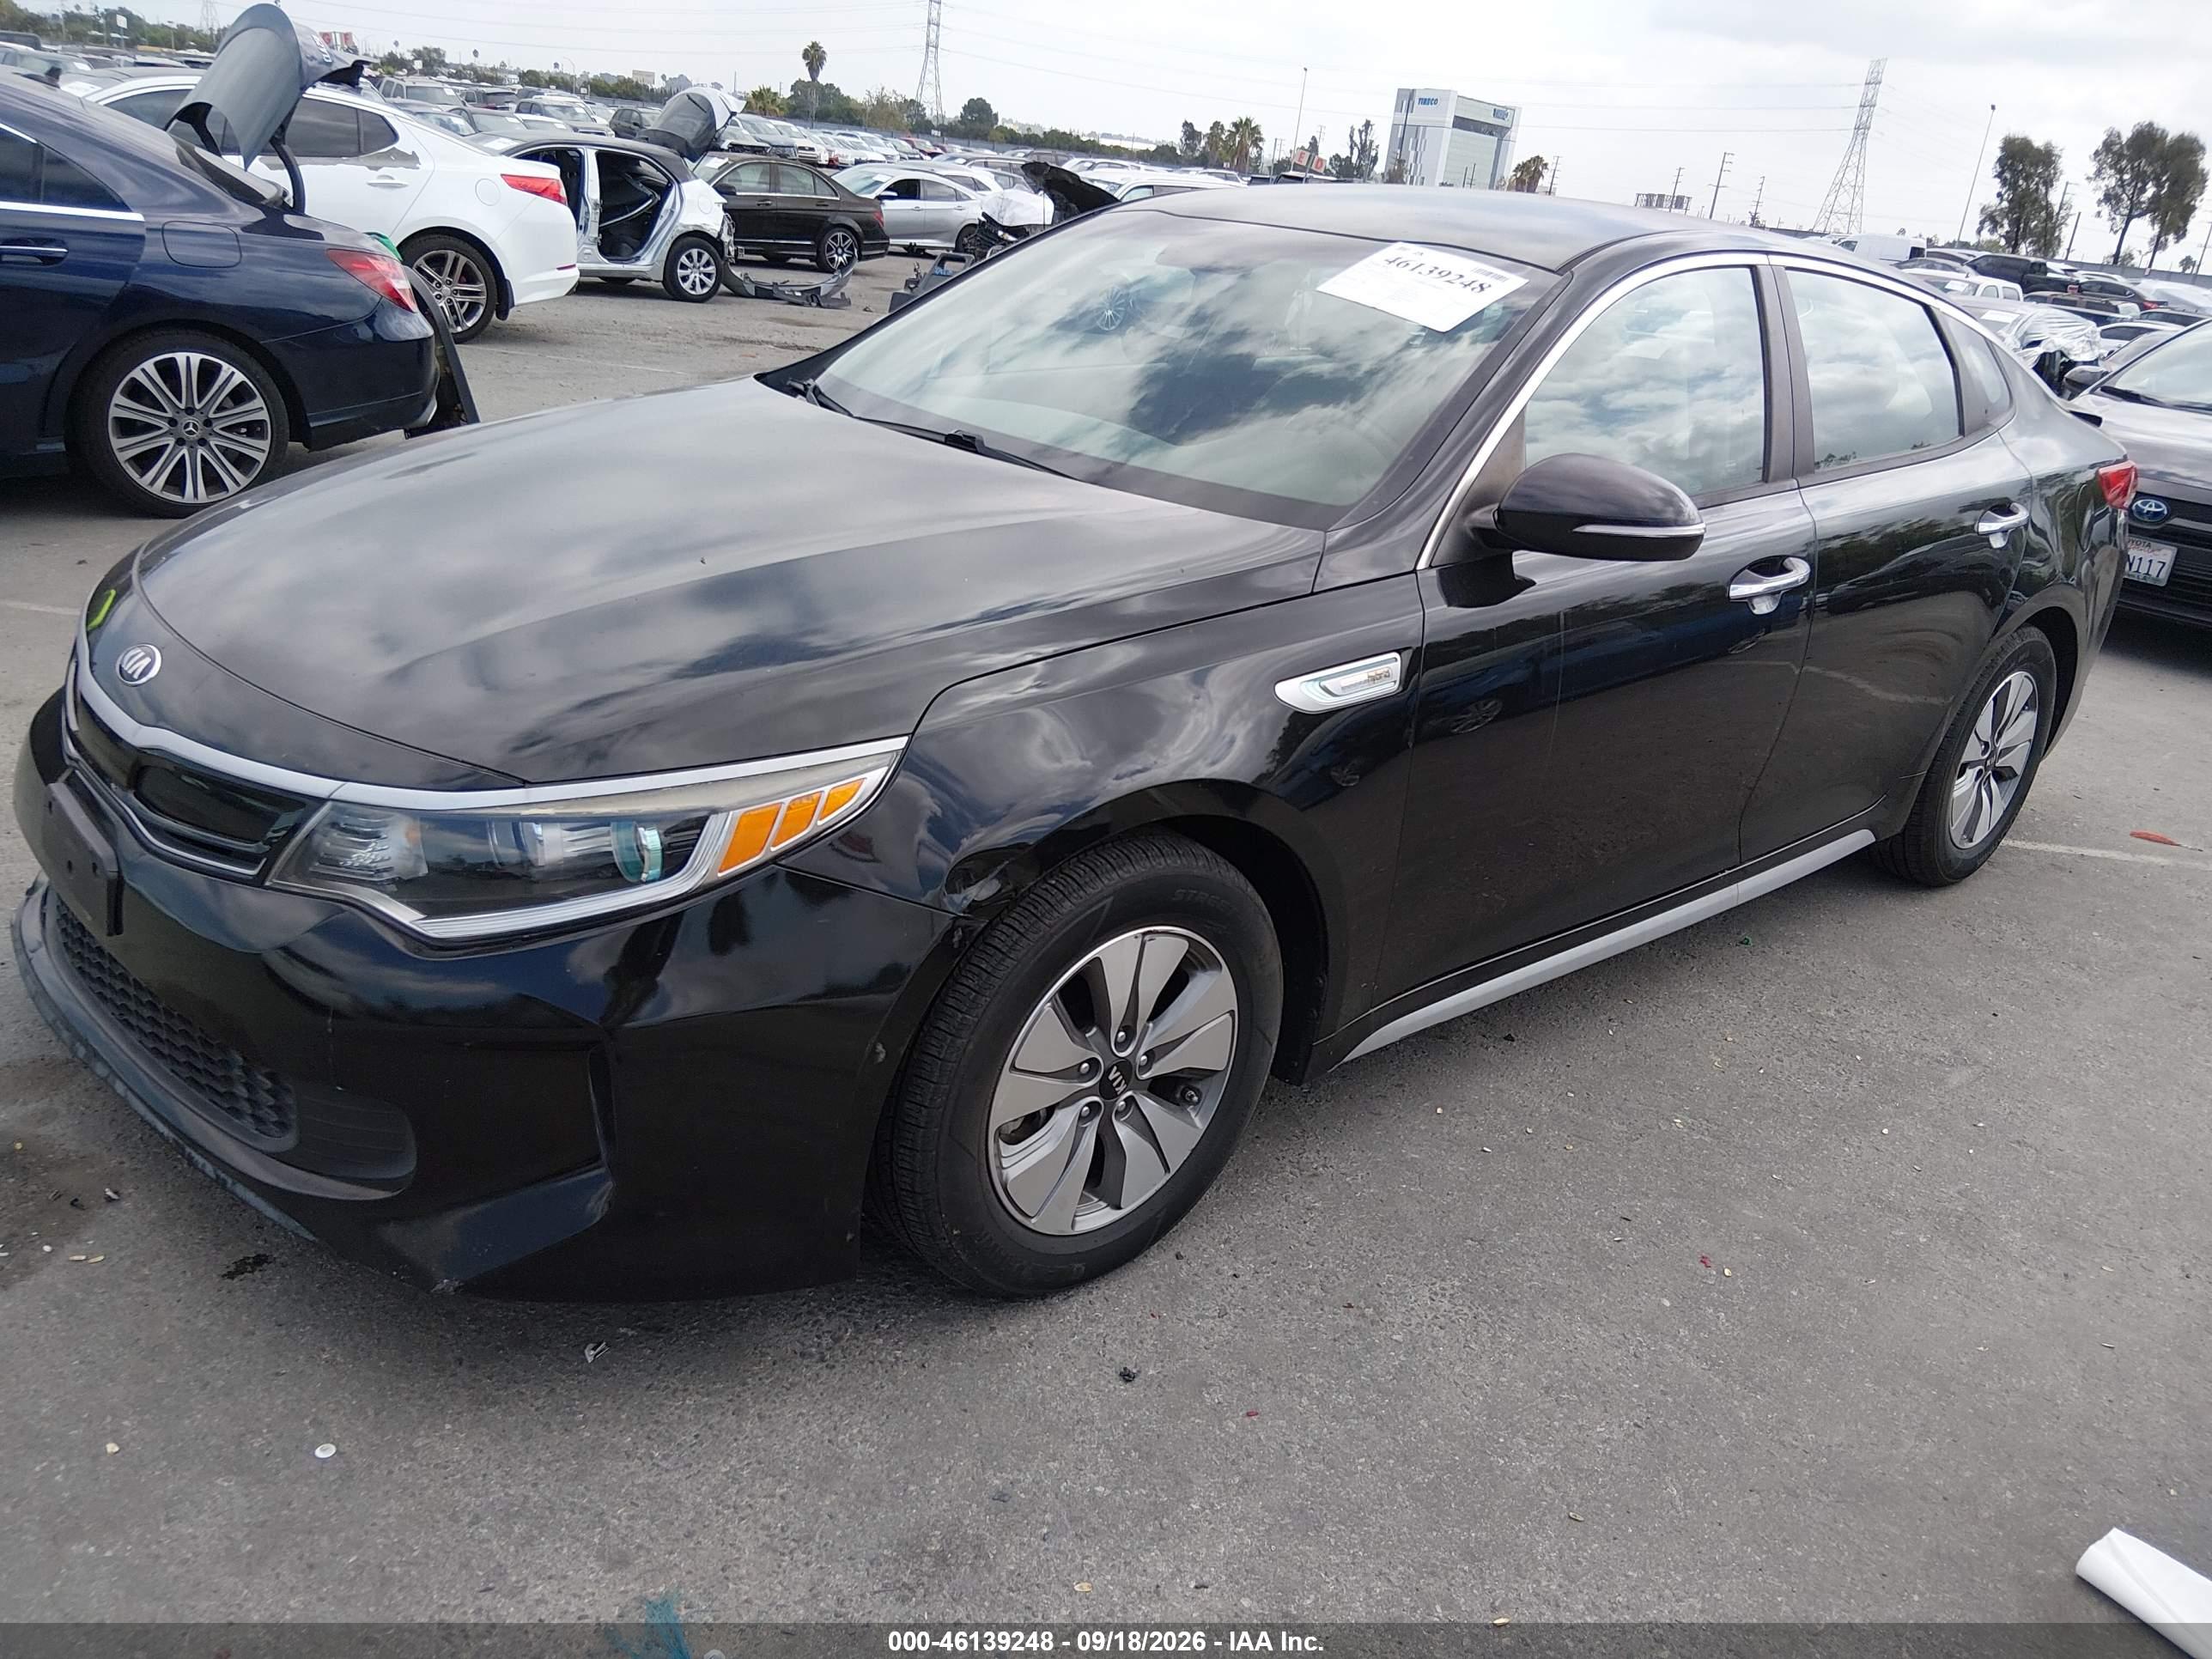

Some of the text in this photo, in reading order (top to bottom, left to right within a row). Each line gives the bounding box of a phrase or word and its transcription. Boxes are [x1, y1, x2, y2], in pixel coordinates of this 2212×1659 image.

[1383, 256, 1492, 293] 46139248
[2129, 538, 2152, 549] YOTA
[2128, 554, 2166, 578] N117
[1108, 1065, 1127, 1096] KIA
